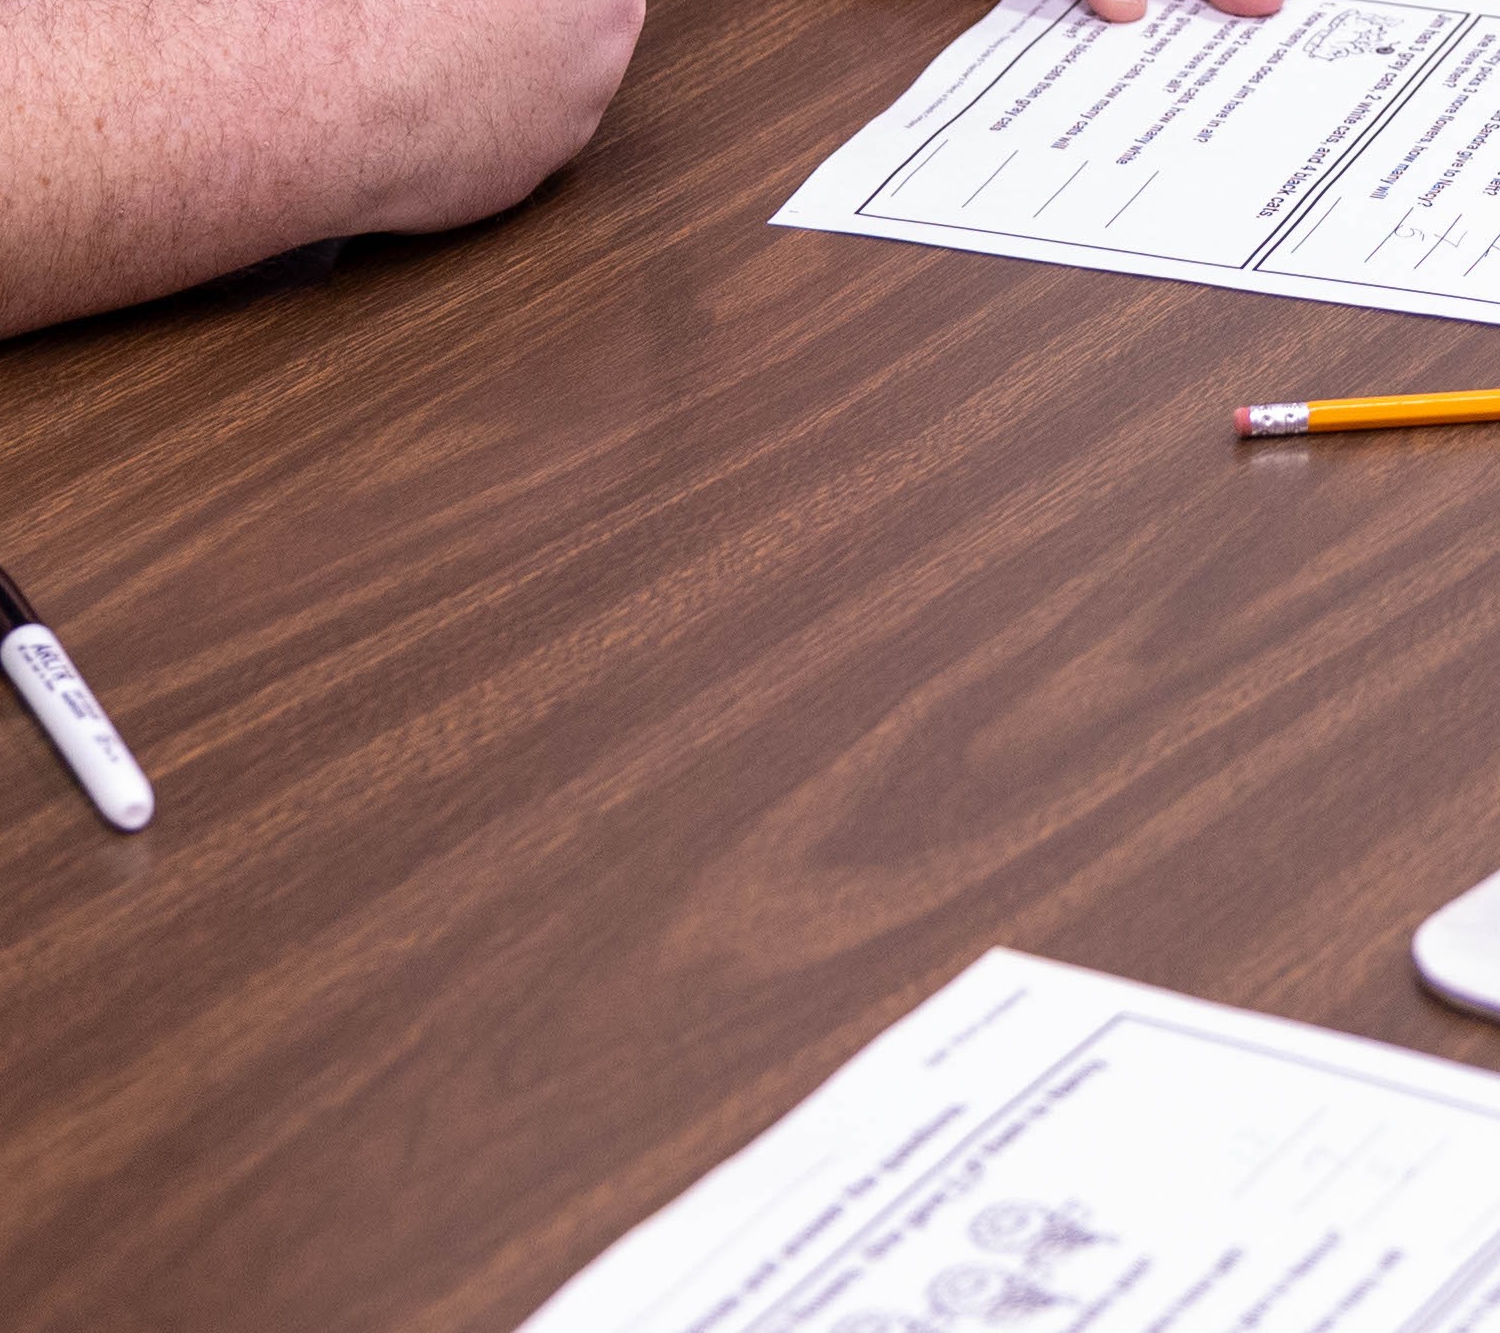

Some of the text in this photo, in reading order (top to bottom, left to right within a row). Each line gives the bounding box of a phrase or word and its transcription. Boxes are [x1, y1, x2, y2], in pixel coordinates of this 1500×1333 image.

[1302, 11, 1325, 27] How
[1429, 13, 1451, 28] Jim
[1279, 28, 1307, 47] many
[1414, 29, 1439, 44] has
[1266, 48, 1287, 64] cats
[1387, 52, 1414, 71] gray
[1247, 65, 1272, 83] does
[1369, 72, 1397, 92] cats,
[1233, 84, 1255, 98] Jim
[1215, 99, 1243, 118] have
[1343, 102, 1372, 124] white
[1193, 128, 1213, 143] all?
[1320, 125, 1350, 144] cats,
[1466, 122, 1500, 149] Sandra
[1306, 147, 1330, 164] and
[1451, 150, 1473, 167] give
[1277, 171, 1311, 195] black
[1417, 178, 1453, 207] Nancy?
[1256, 196, 1284, 218] cats.
